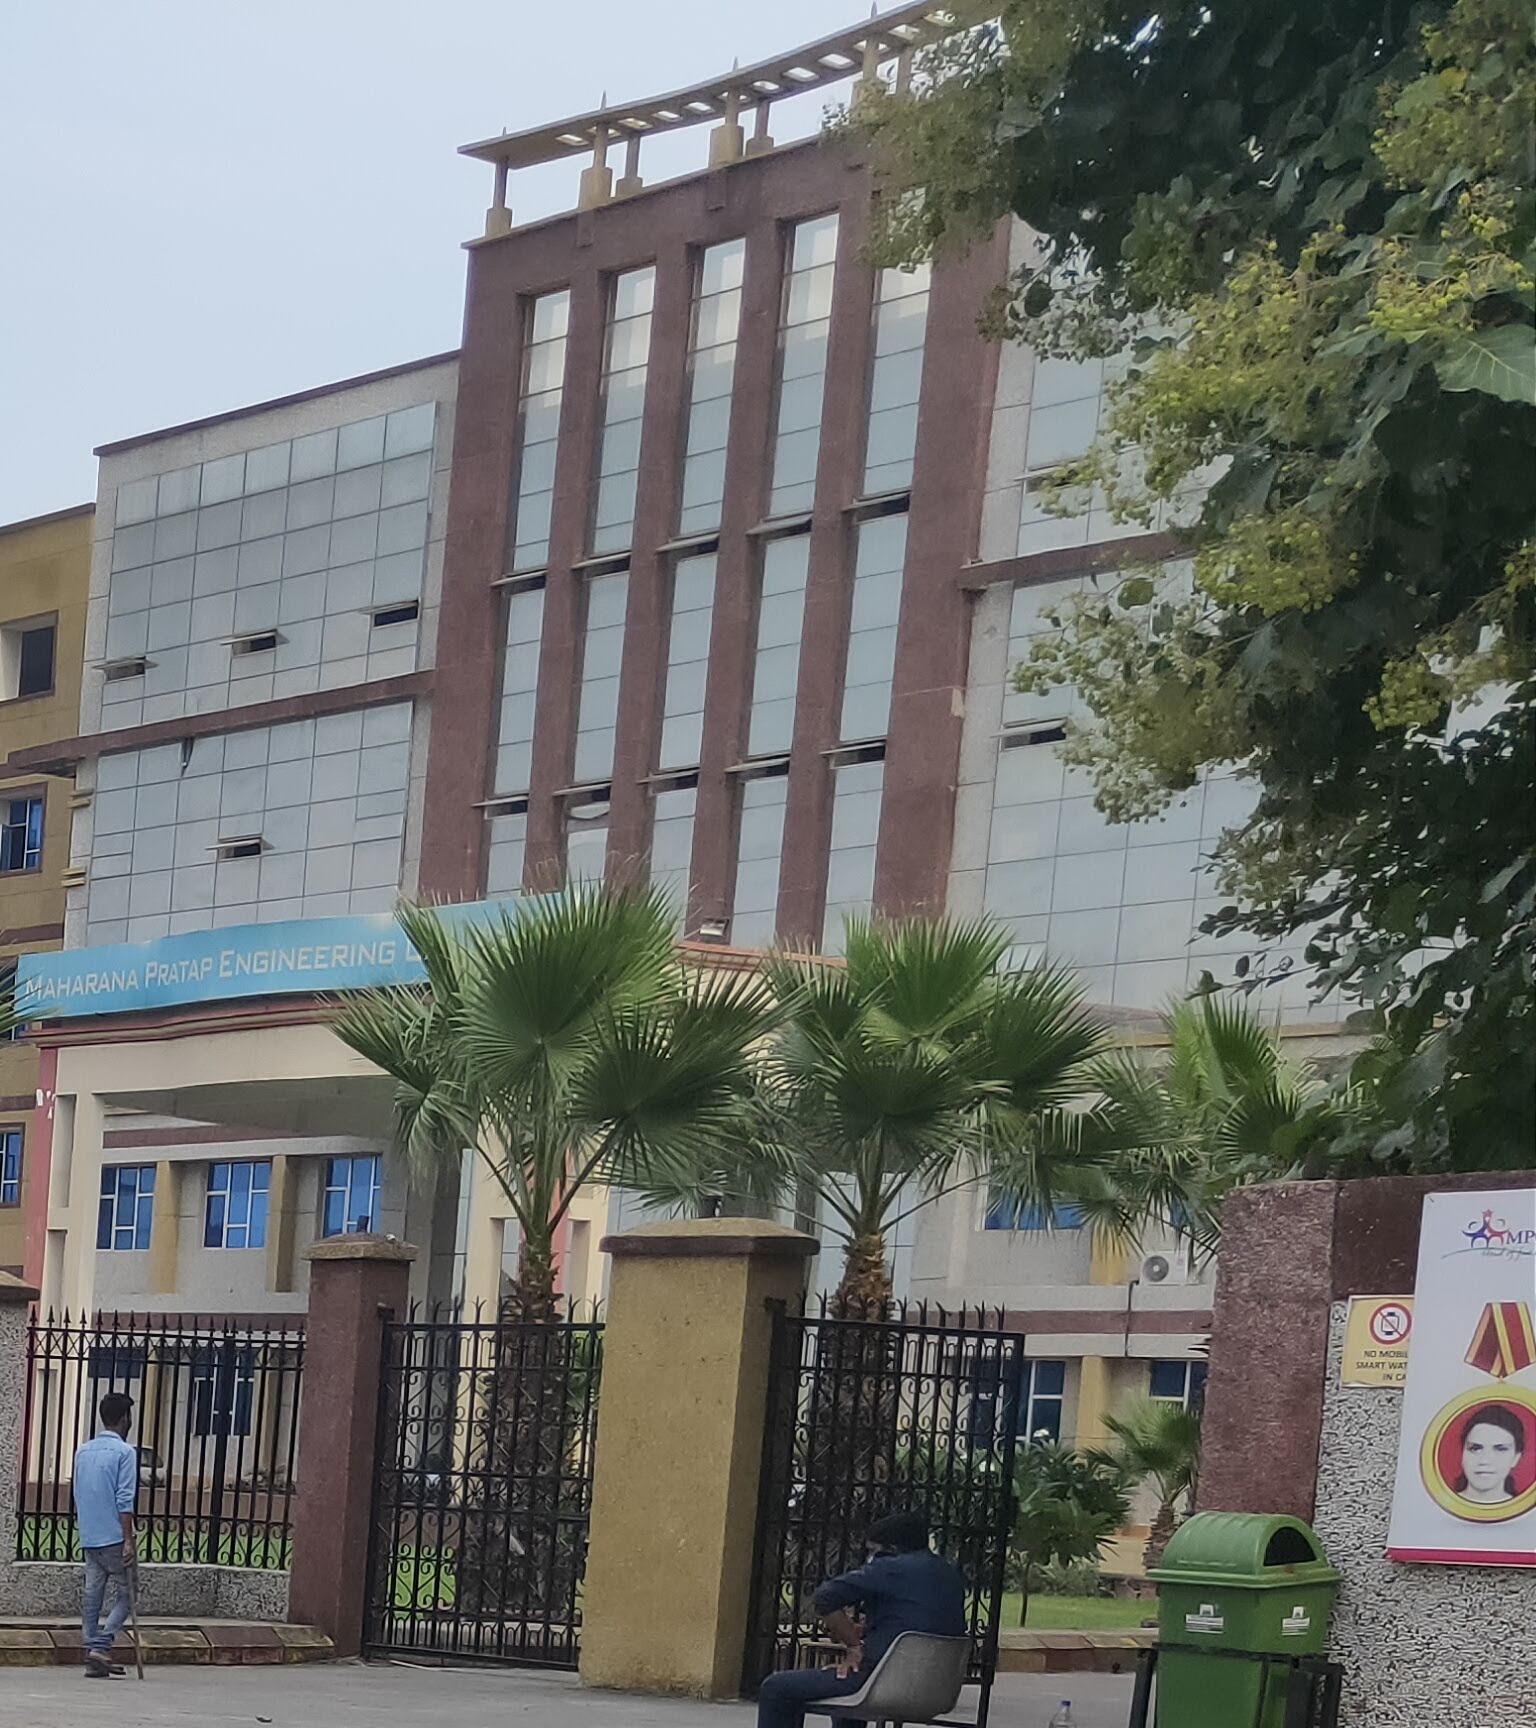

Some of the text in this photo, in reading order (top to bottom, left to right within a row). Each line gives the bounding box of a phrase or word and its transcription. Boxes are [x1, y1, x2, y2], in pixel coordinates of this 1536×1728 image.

[27, 968, 139, 1000] MAHARANA
[145, 956, 213, 988] PRATAP
[219, 940, 396, 978] ENGINEERING
[1506, 1230, 1536, 1245] MP
[1364, 1350, 1409, 1358] NO MOBIL
[1355, 1361, 1408, 1370] SMART WAT
[1383, 1373, 1393, 1381] IN
